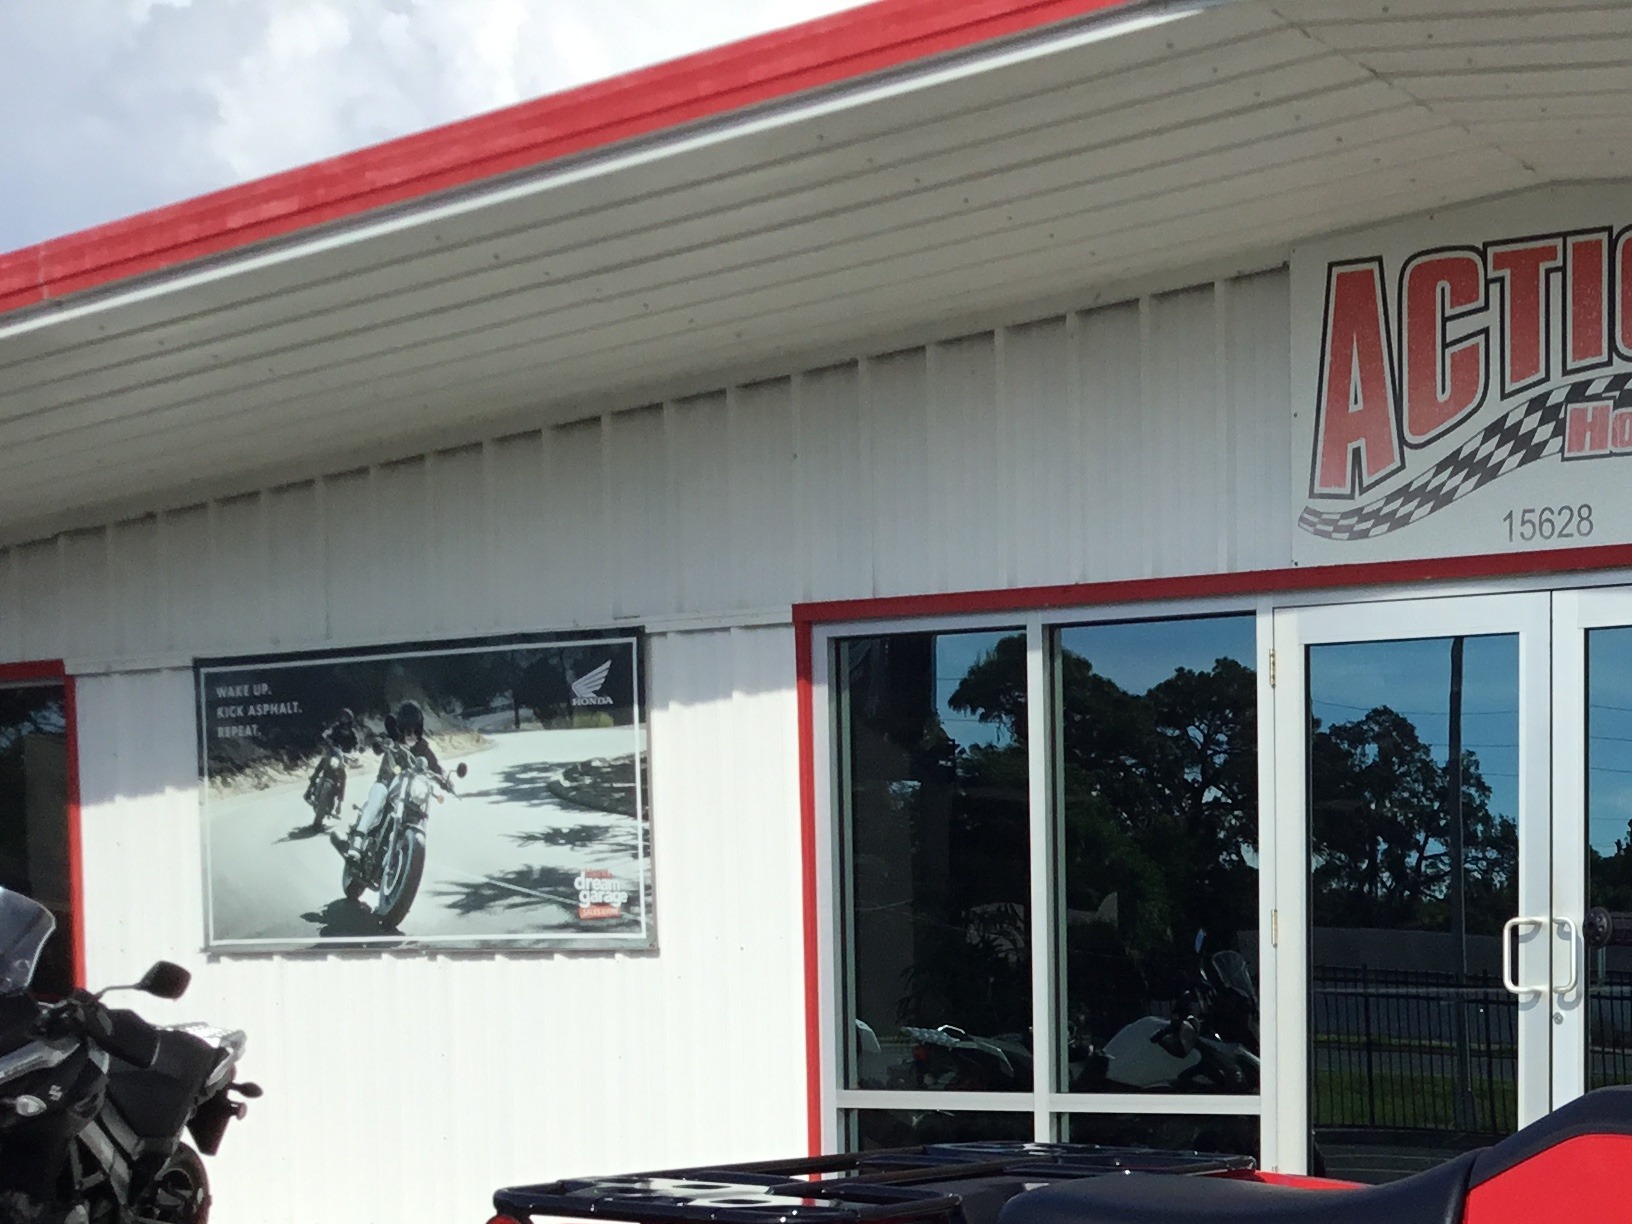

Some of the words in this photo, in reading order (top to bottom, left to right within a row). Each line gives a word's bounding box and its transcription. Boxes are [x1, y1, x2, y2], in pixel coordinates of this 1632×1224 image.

[1502, 504, 1595, 542] 15628
[216, 685, 249, 698] WAKE
[252, 683, 272, 697] UP.
[217, 705, 245, 719] KICK
[248, 701, 303, 717] ASPHALT.
[572, 696, 614, 706] HONDA
[217, 724, 262, 738] REPEAT.
[574, 870, 620, 891] dream
[578, 890, 628, 908] garage
